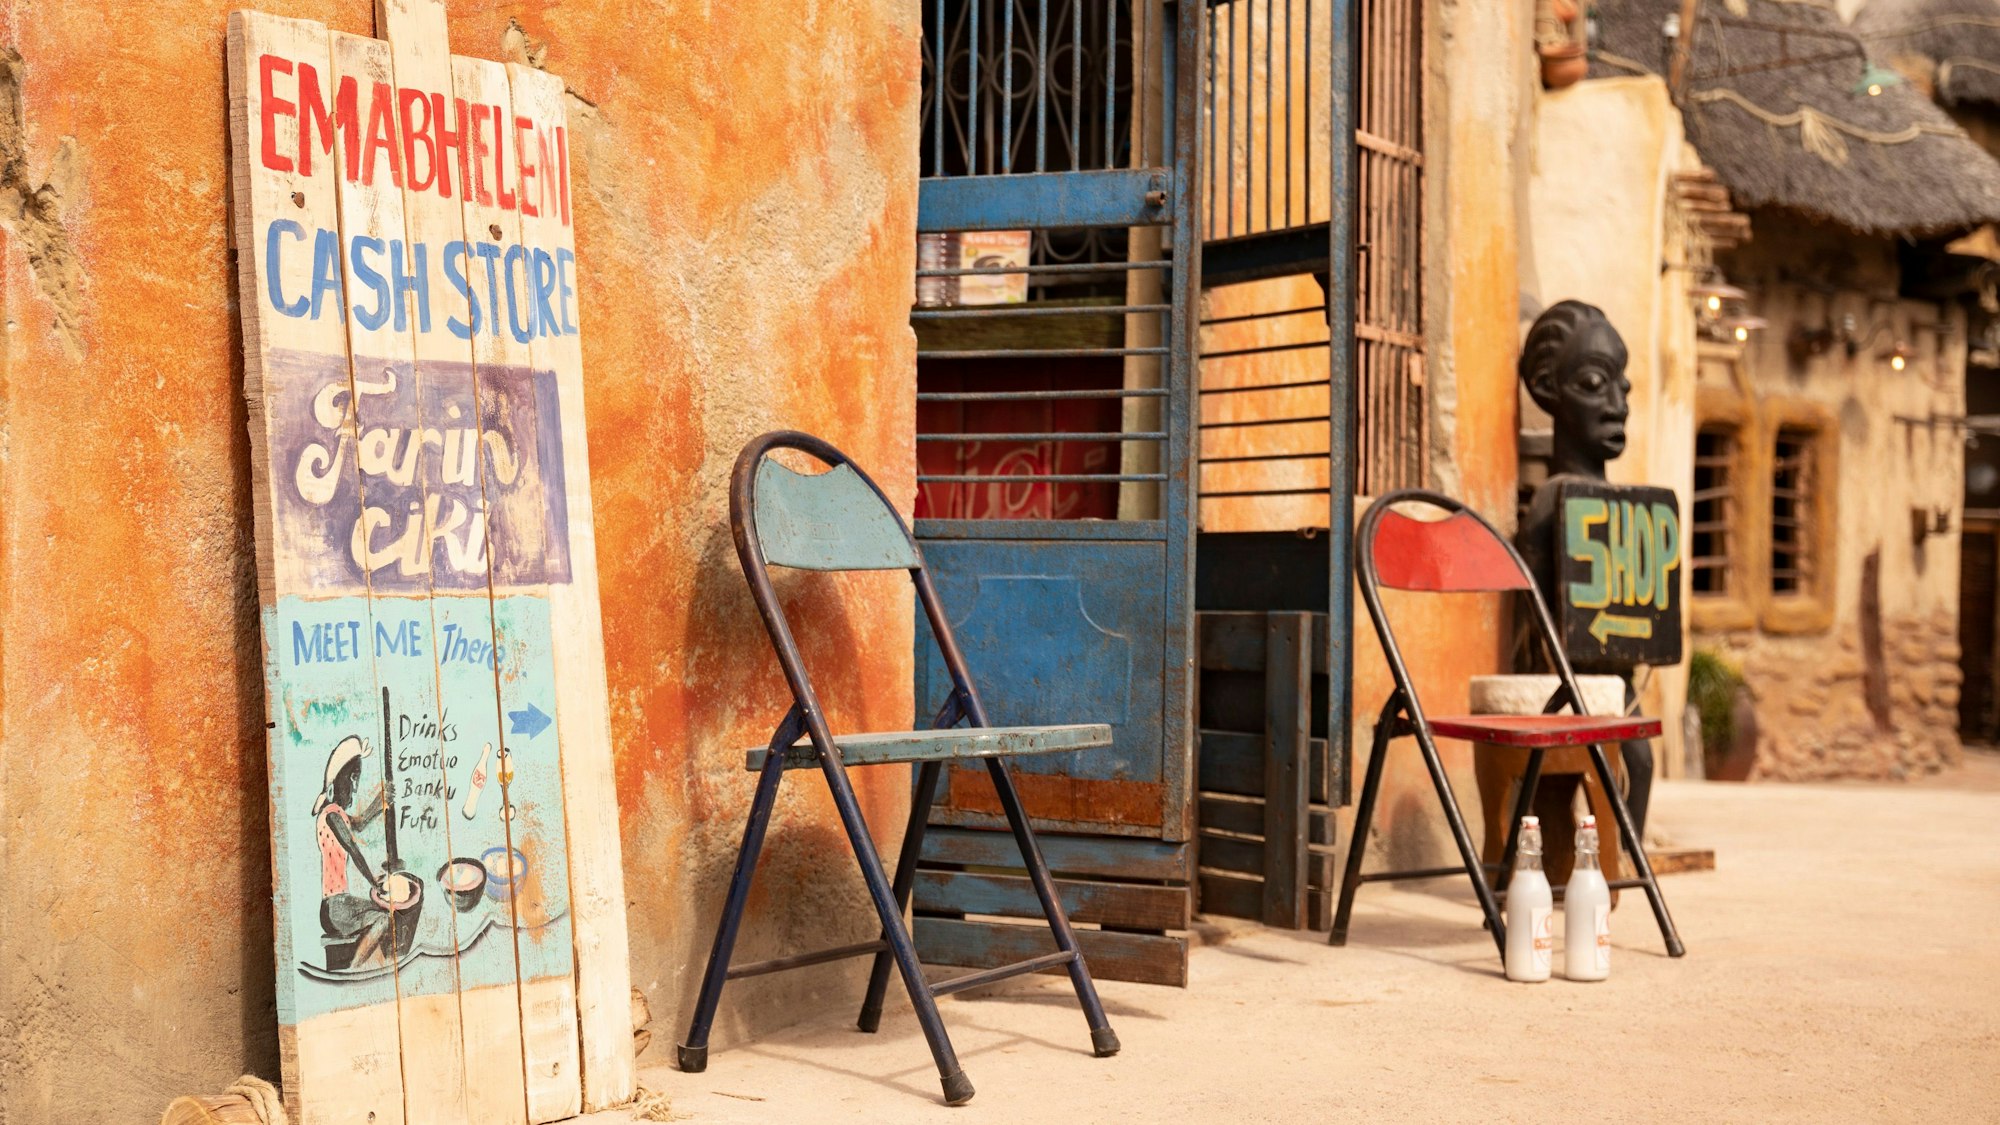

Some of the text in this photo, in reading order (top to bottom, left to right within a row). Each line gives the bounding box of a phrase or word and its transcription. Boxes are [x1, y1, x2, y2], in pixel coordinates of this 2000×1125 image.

[259, 54, 569, 226] EMABHELENI
[266, 219, 578, 344] CASH STORE
[1565, 497, 1680, 611] SHOP
[292, 620, 361, 666] MEET
[375, 619, 422, 657] ME
[400, 707, 458, 742] Drinks
[401, 777, 457, 800] Banku
[400, 805, 438, 833] Fufu
